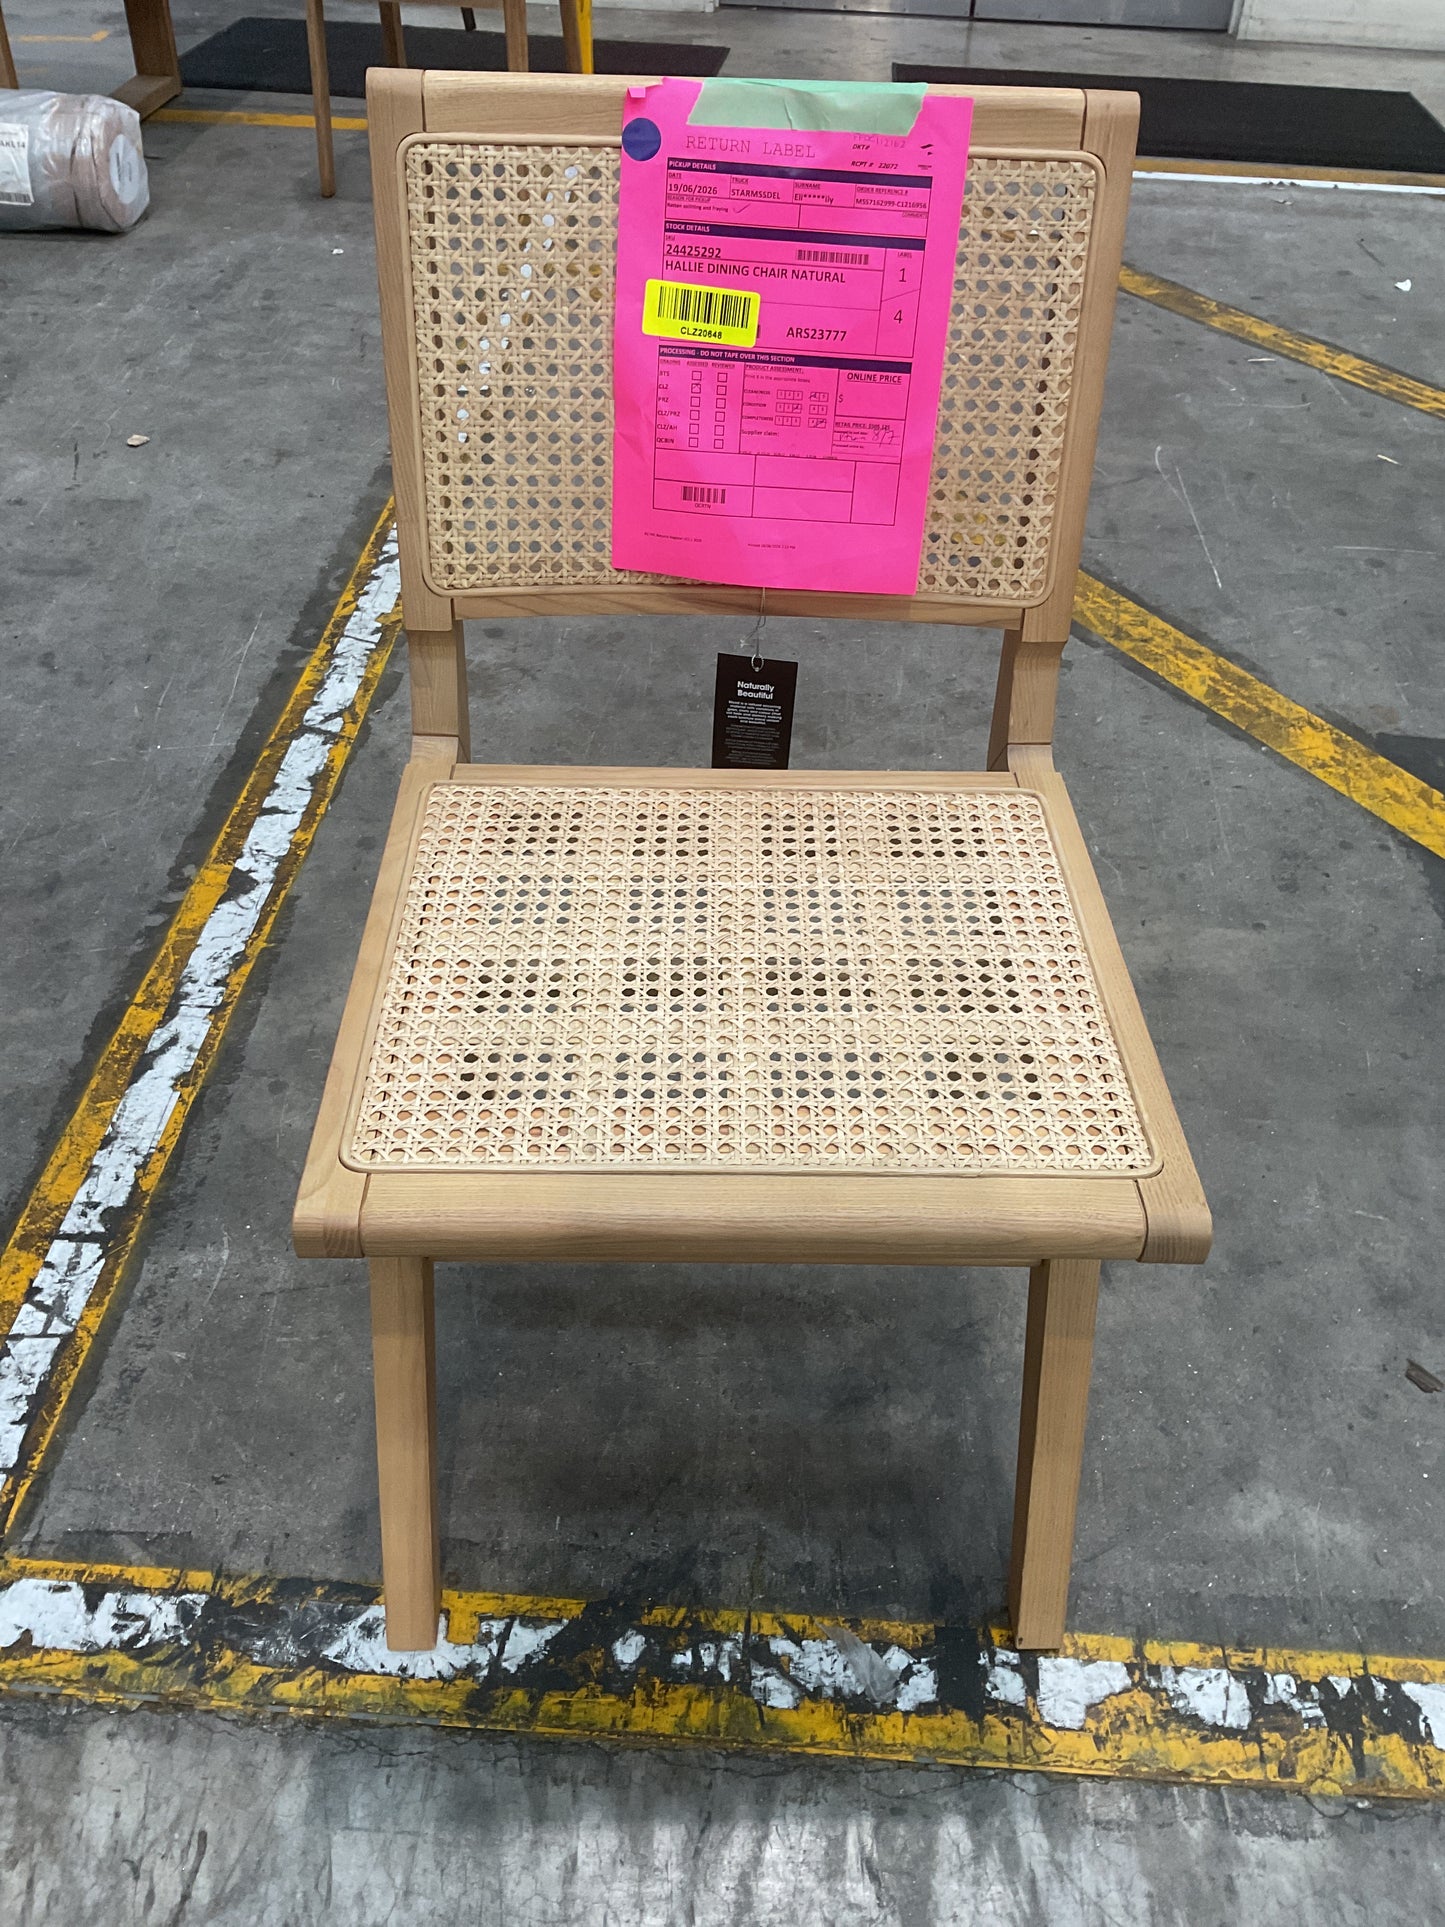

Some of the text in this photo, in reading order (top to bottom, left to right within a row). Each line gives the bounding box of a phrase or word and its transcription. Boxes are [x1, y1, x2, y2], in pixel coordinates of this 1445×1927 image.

[686, 135, 816, 158] RETURN LABEL
[669, 183, 718, 195] 19/06/2026
[795, 182, 821, 190] SURNAME
[857, 186, 875, 194] ORDER
[875, 187, 904, 195] REFERENCE
[731, 189, 781, 200] STARMSSDEL
[666, 244, 722, 259] 24425292
[665, 260, 846, 283] HALLIE DINING CHAIR NATURAL
[898, 267, 907, 282] 1
[893, 309, 903, 324] 4
[680, 326, 723, 340] CLZ20648
[786, 326, 847, 341] ARS23777
[660, 347, 696, 356] PROCESSING
[740, 352, 756, 360] OVER
[770, 354, 796, 362] SECTION
[745, 364, 770, 372] PRODUCT
[847, 372, 902, 385] ONLINE PRICE
[838, 393, 844, 404] $
[737, 681, 775, 692] Naturally
[737, 689, 774, 699] Beautiful
